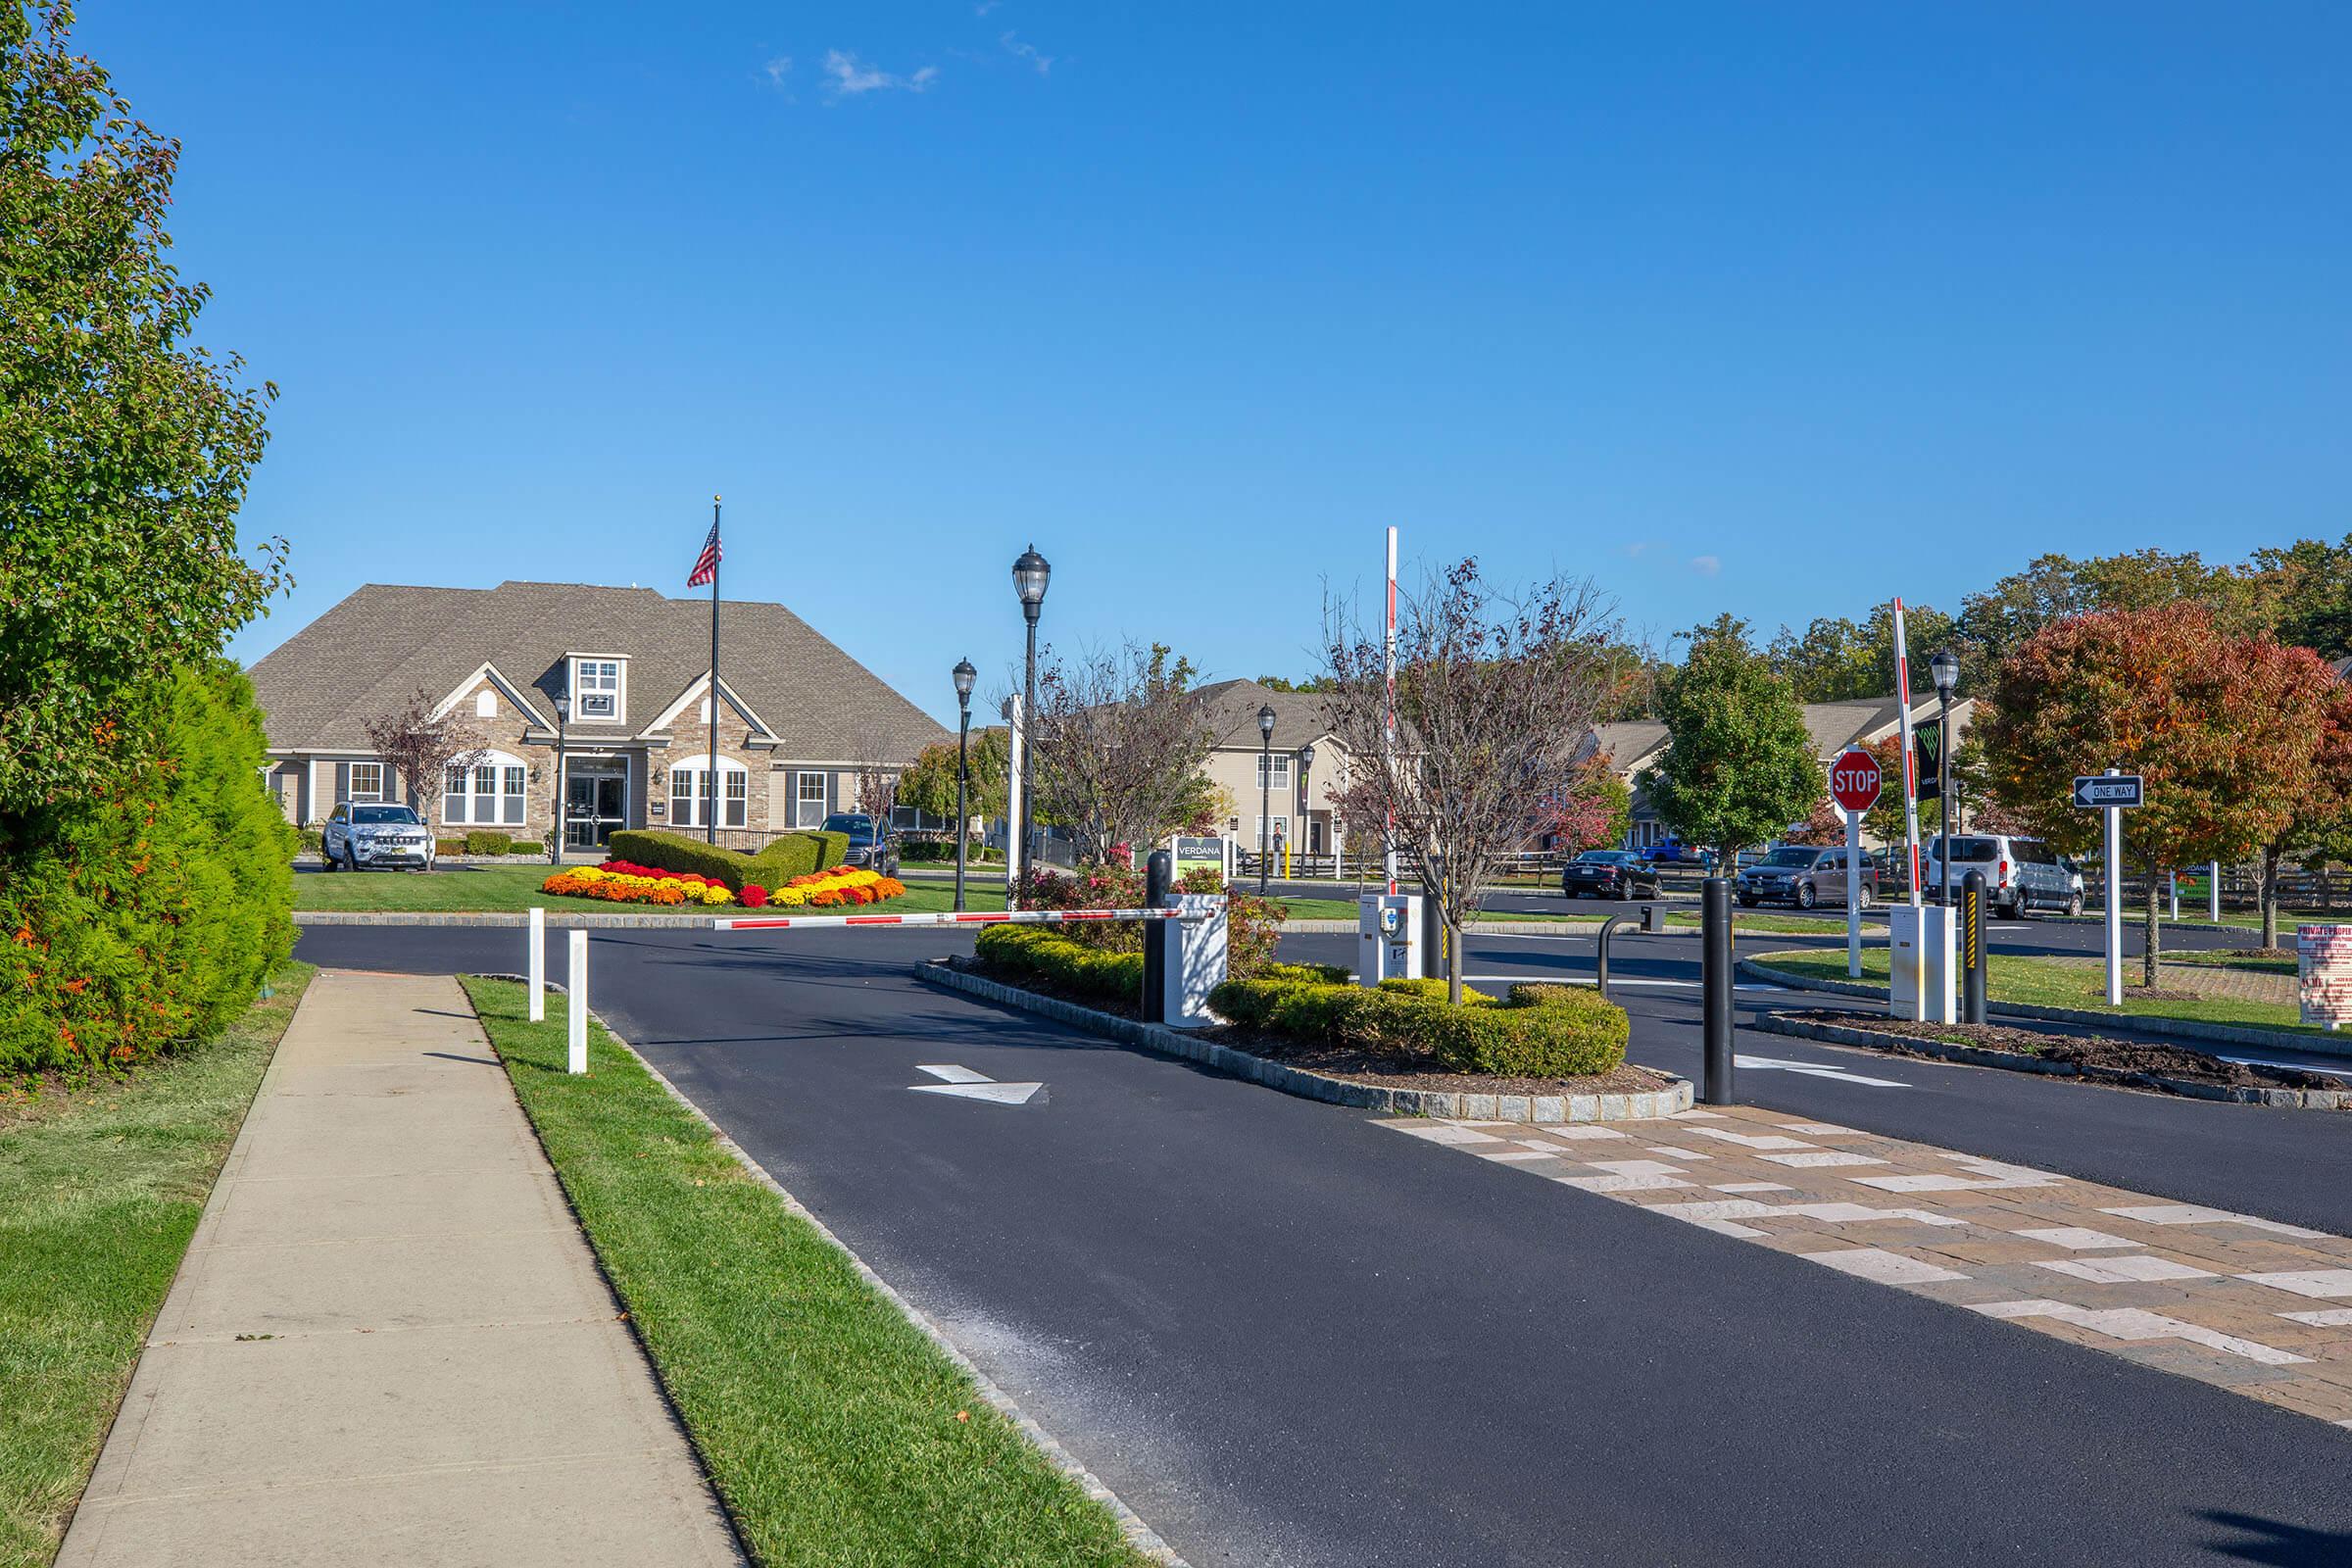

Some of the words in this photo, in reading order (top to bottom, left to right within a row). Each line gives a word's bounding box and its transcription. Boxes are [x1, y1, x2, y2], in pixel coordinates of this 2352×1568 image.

[1835, 769, 1878, 793] STOP
[2093, 786, 2112, 798] ONE
[2114, 786, 2133, 797] WAY
[2298, 926, 2328, 935] PRIVATE
